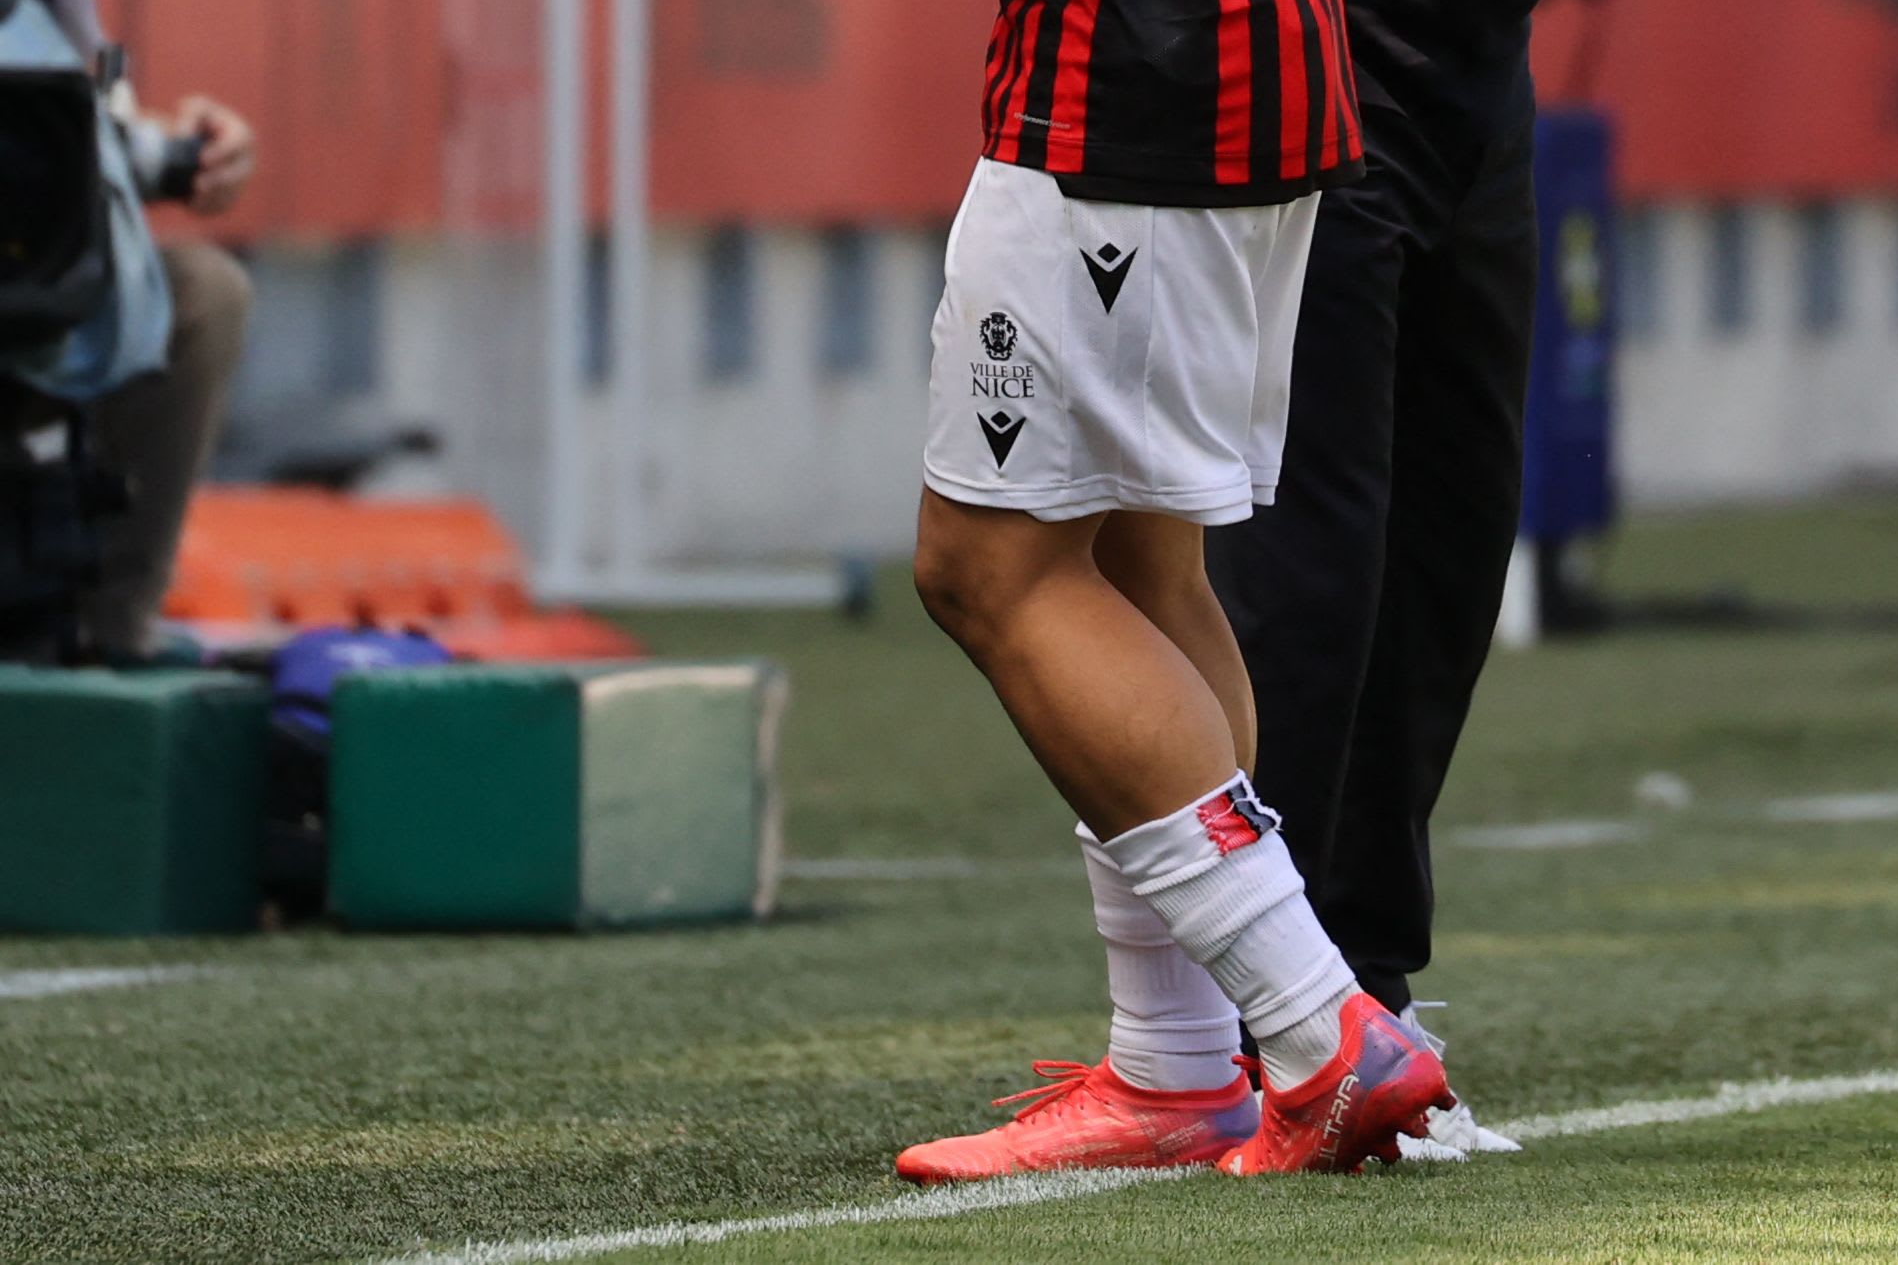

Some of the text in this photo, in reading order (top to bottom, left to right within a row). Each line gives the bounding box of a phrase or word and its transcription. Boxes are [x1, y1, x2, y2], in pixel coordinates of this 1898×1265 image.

[969, 361, 1034, 378] VILLE DE
[971, 376, 1035, 399] NICE
